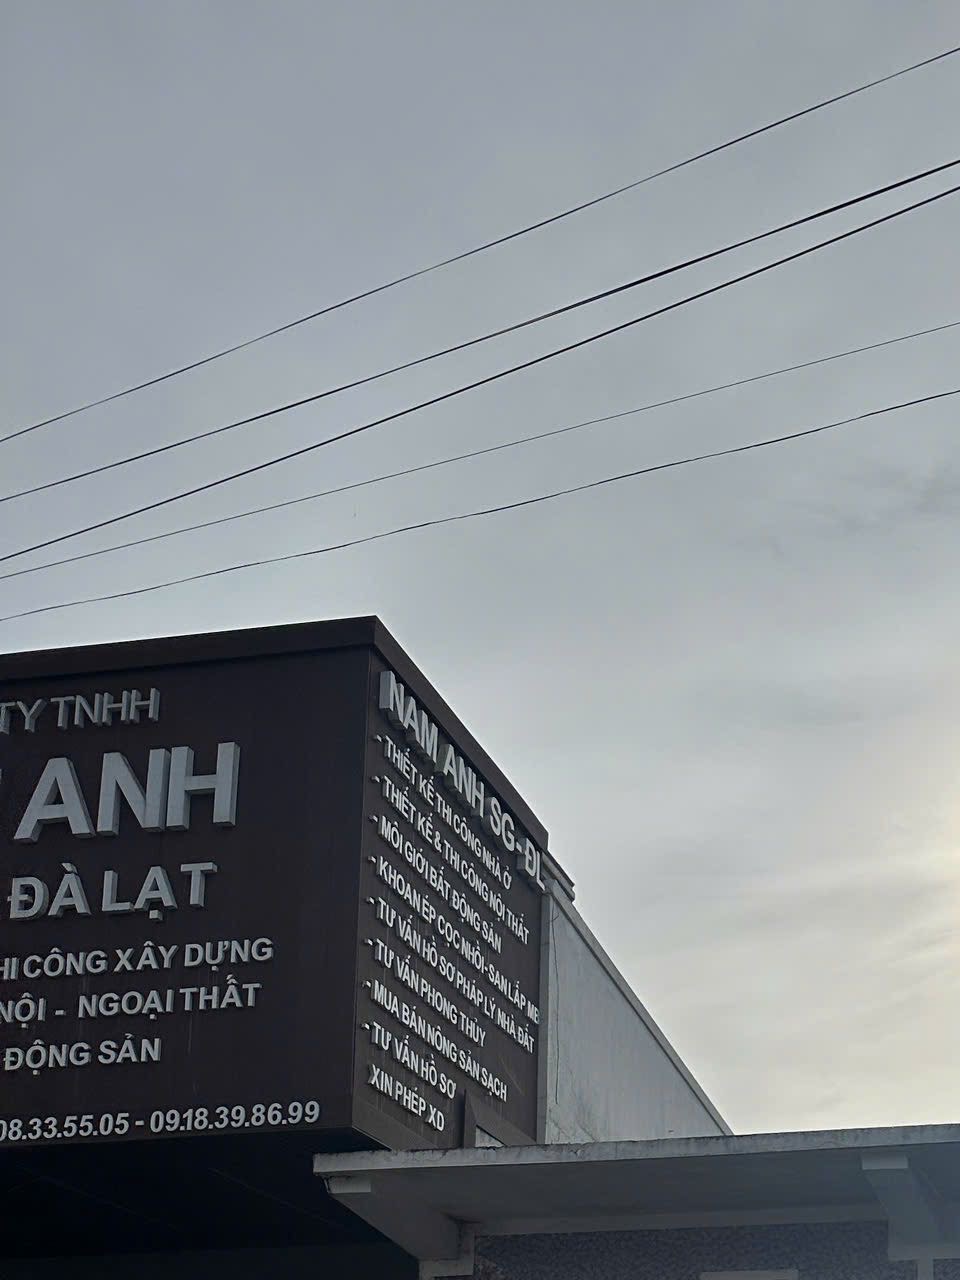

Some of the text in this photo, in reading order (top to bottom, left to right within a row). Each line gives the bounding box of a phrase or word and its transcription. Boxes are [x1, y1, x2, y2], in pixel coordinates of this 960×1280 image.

[51, 687, 160, 730] TNHH
[379, 671, 439, 763] NAM
[436, 743, 485, 818] ANH
[13, 742, 241, 842] ANH
[384, 735, 418, 785] THIẾT
[418, 776, 435, 807] KẾ
[435, 792, 452, 826] THI
[453, 814, 481, 858] CÔNG
[482, 846, 502, 882] NHÀ
[7, 861, 218, 922] ĐÀ LẠT
[378, 856, 421, 913] KHOAN
[421, 895, 437, 925] ÉP
[437, 914, 461, 950] CỌC
[379, 815, 502, 954] MÔI GIỚI BẤT ĐỘNG SẢN
[383, 775, 530, 945] THIẾT KẾ & THI CÔNG NỘI THẤT
[0, 992, 47, 1029] NỘI
[78, 988, 174, 1020] NGOẠI
[179, 973, 262, 1012] THẤT
[23, 947, 109, 980] CÔNG
[113, 940, 178, 973] XÂY
[184, 936, 274, 972] DỰNG
[375, 938, 487, 1048] TƯ VẤN PHONG THỦY
[377, 897, 535, 1055] TƯ VẤN HỒ SƠ PHÁP LÝ NHÀ ĐẤT
[3, 1032, 162, 1076] ĐỘNG SẢN
[372, 979, 508, 1103] MUA BÁN NÔNG SẢN SẠCH
[372, 1021, 457, 1100] TƯ VẤN HỒ SƠ
[369, 1063, 445, 1133] XIN PHÉP XD
